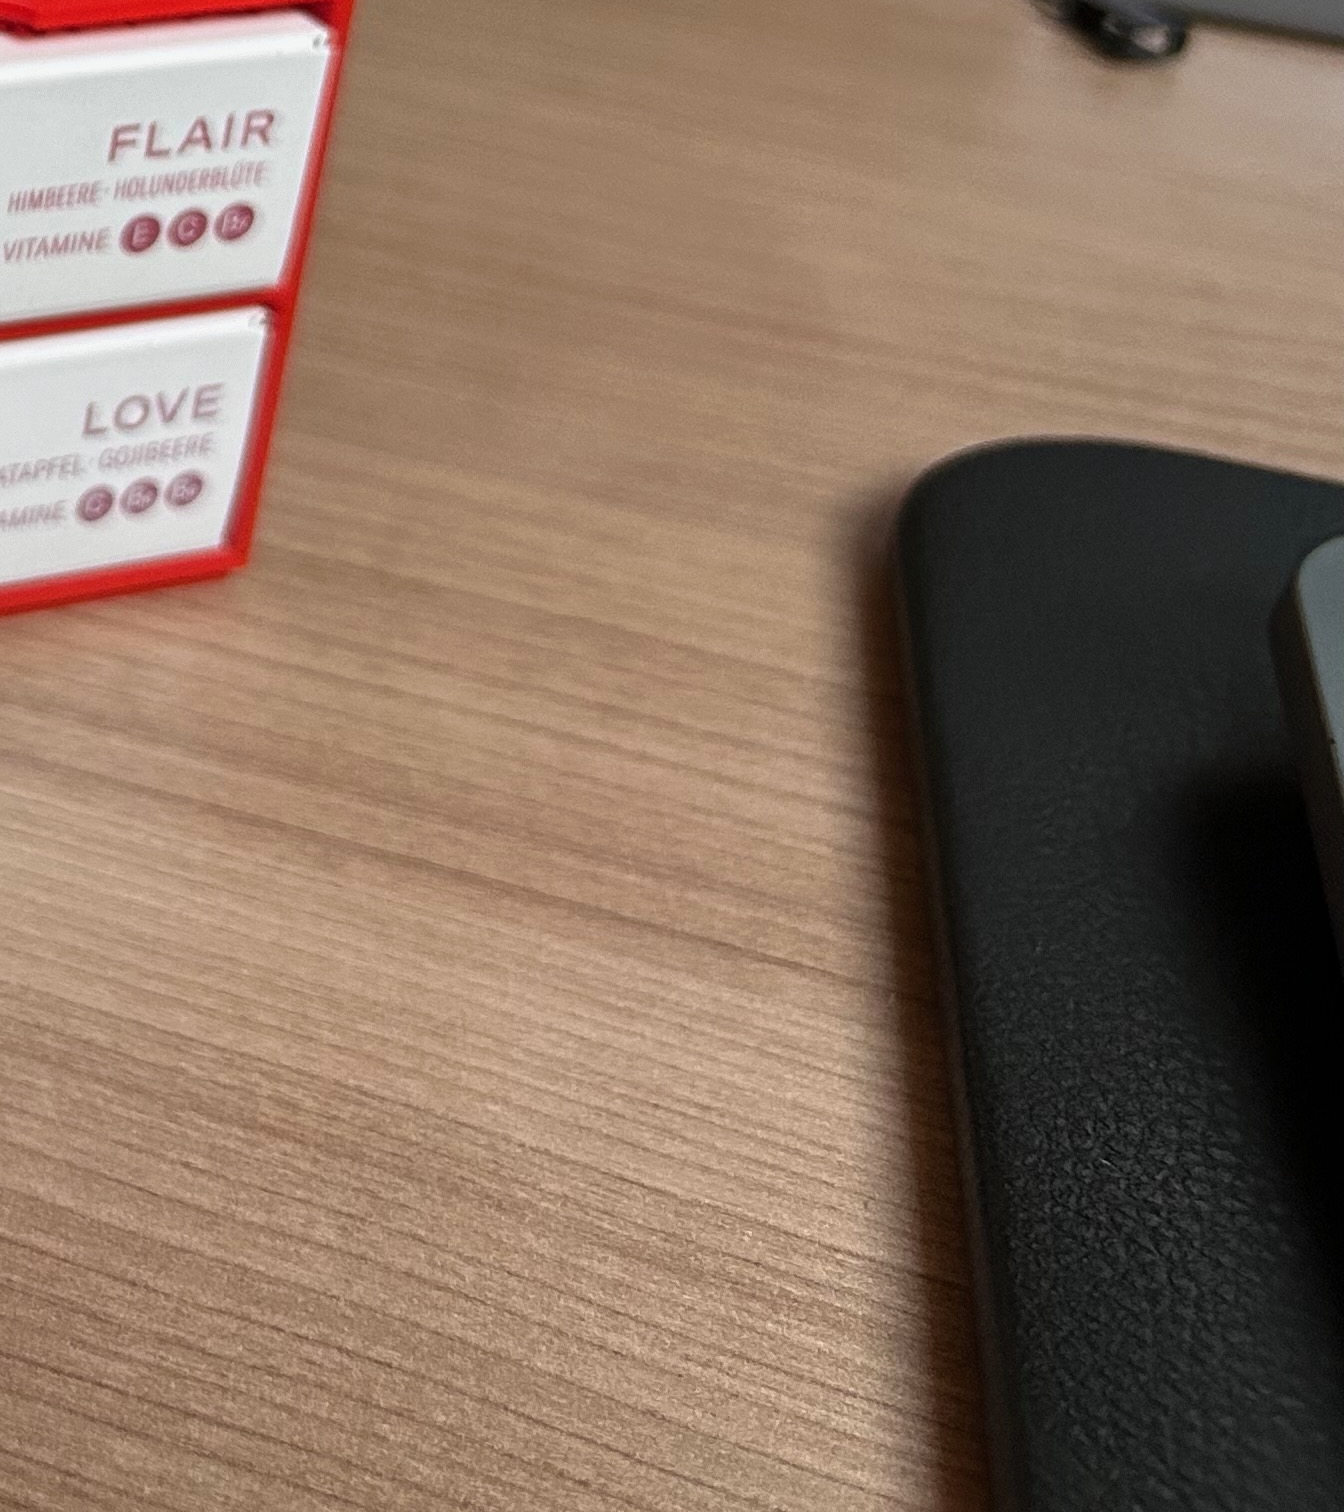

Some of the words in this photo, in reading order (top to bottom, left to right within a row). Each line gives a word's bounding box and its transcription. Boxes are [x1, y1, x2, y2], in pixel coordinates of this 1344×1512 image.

[107, 108, 278, 163] FLAIR
[7, 179, 102, 215] HIMBEERE
[113, 159, 270, 201] HOLUNDERBLÜTE
[2, 226, 111, 264] VITAMINE
[83, 383, 224, 437] LOVE
